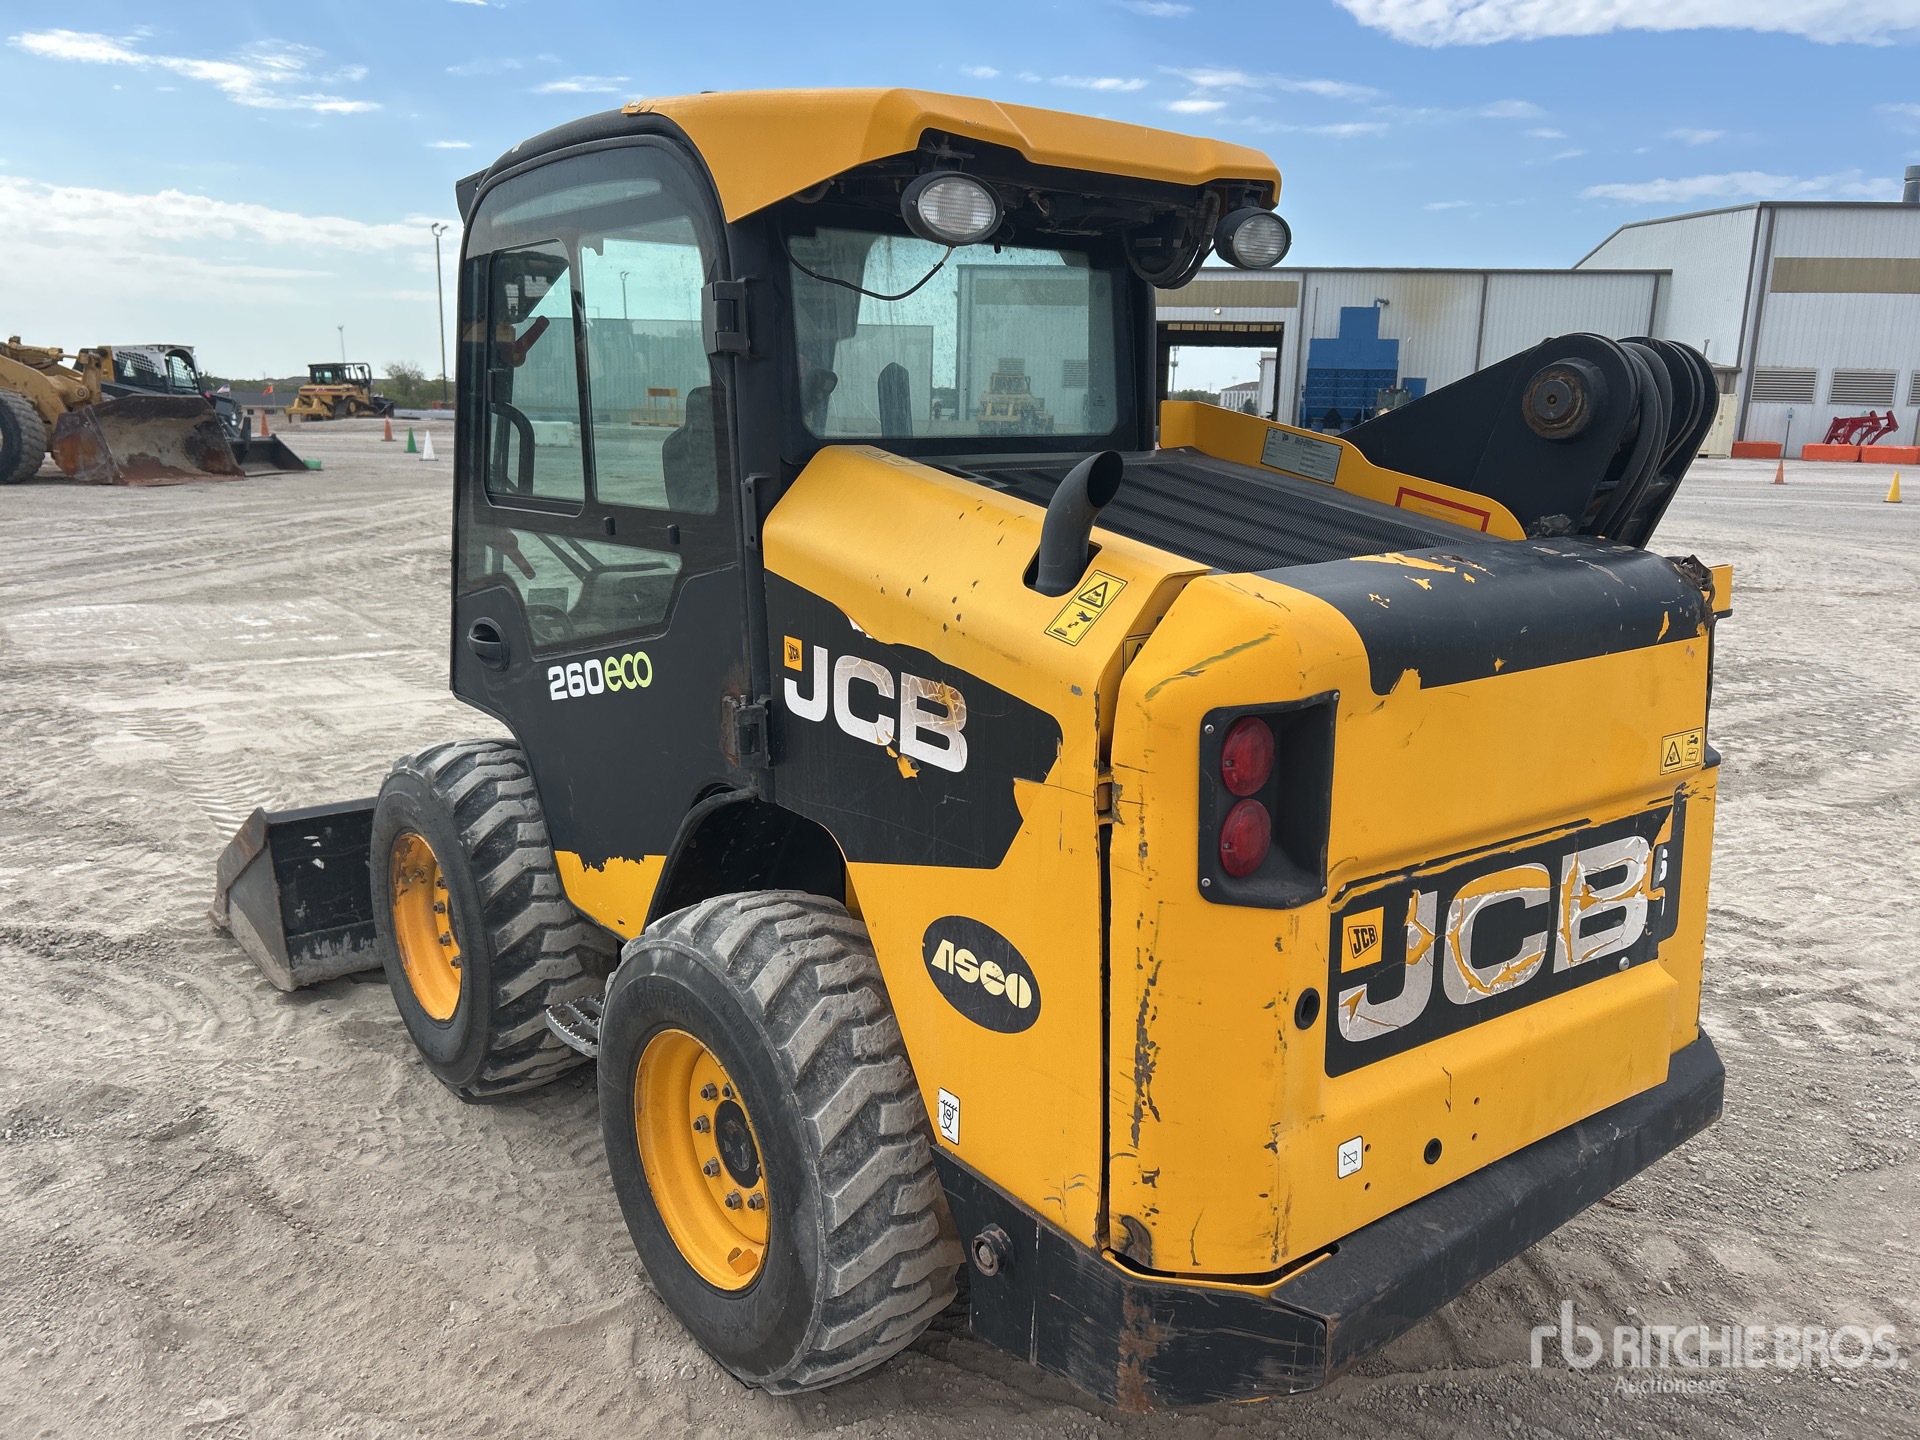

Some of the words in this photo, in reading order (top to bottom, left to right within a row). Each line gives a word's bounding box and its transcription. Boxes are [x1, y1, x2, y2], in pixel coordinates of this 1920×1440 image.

[784, 645, 967, 773] JCB
[1338, 835, 1650, 1042] JCB
[1353, 925, 1377, 957] JCB
